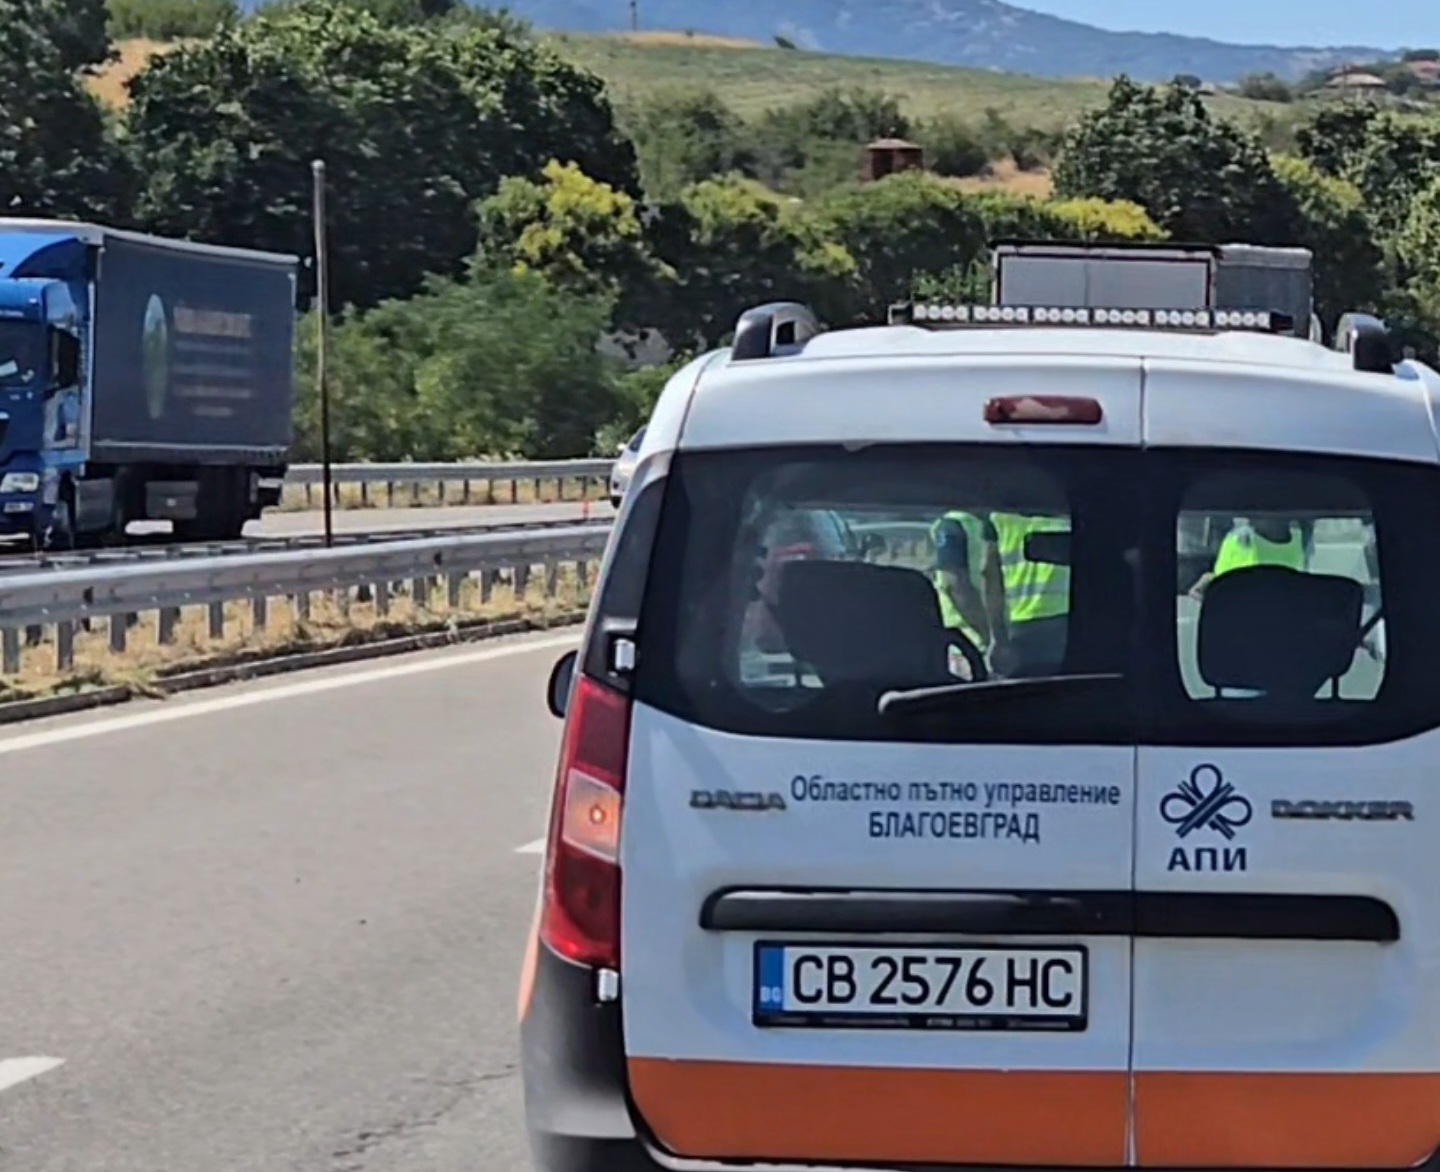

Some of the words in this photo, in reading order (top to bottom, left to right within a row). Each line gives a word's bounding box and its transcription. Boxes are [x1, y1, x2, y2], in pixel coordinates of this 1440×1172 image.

[790, 774, 901, 802] Областно
[908, 782, 977, 801] пътно
[983, 782, 1121, 808] управление
[1271, 799, 1415, 821] DOKKER
[868, 811, 1041, 844] БЛАГОЕВГРАД
[1167, 847, 1248, 872] АПИ
[869, 956, 994, 1006] 2576
